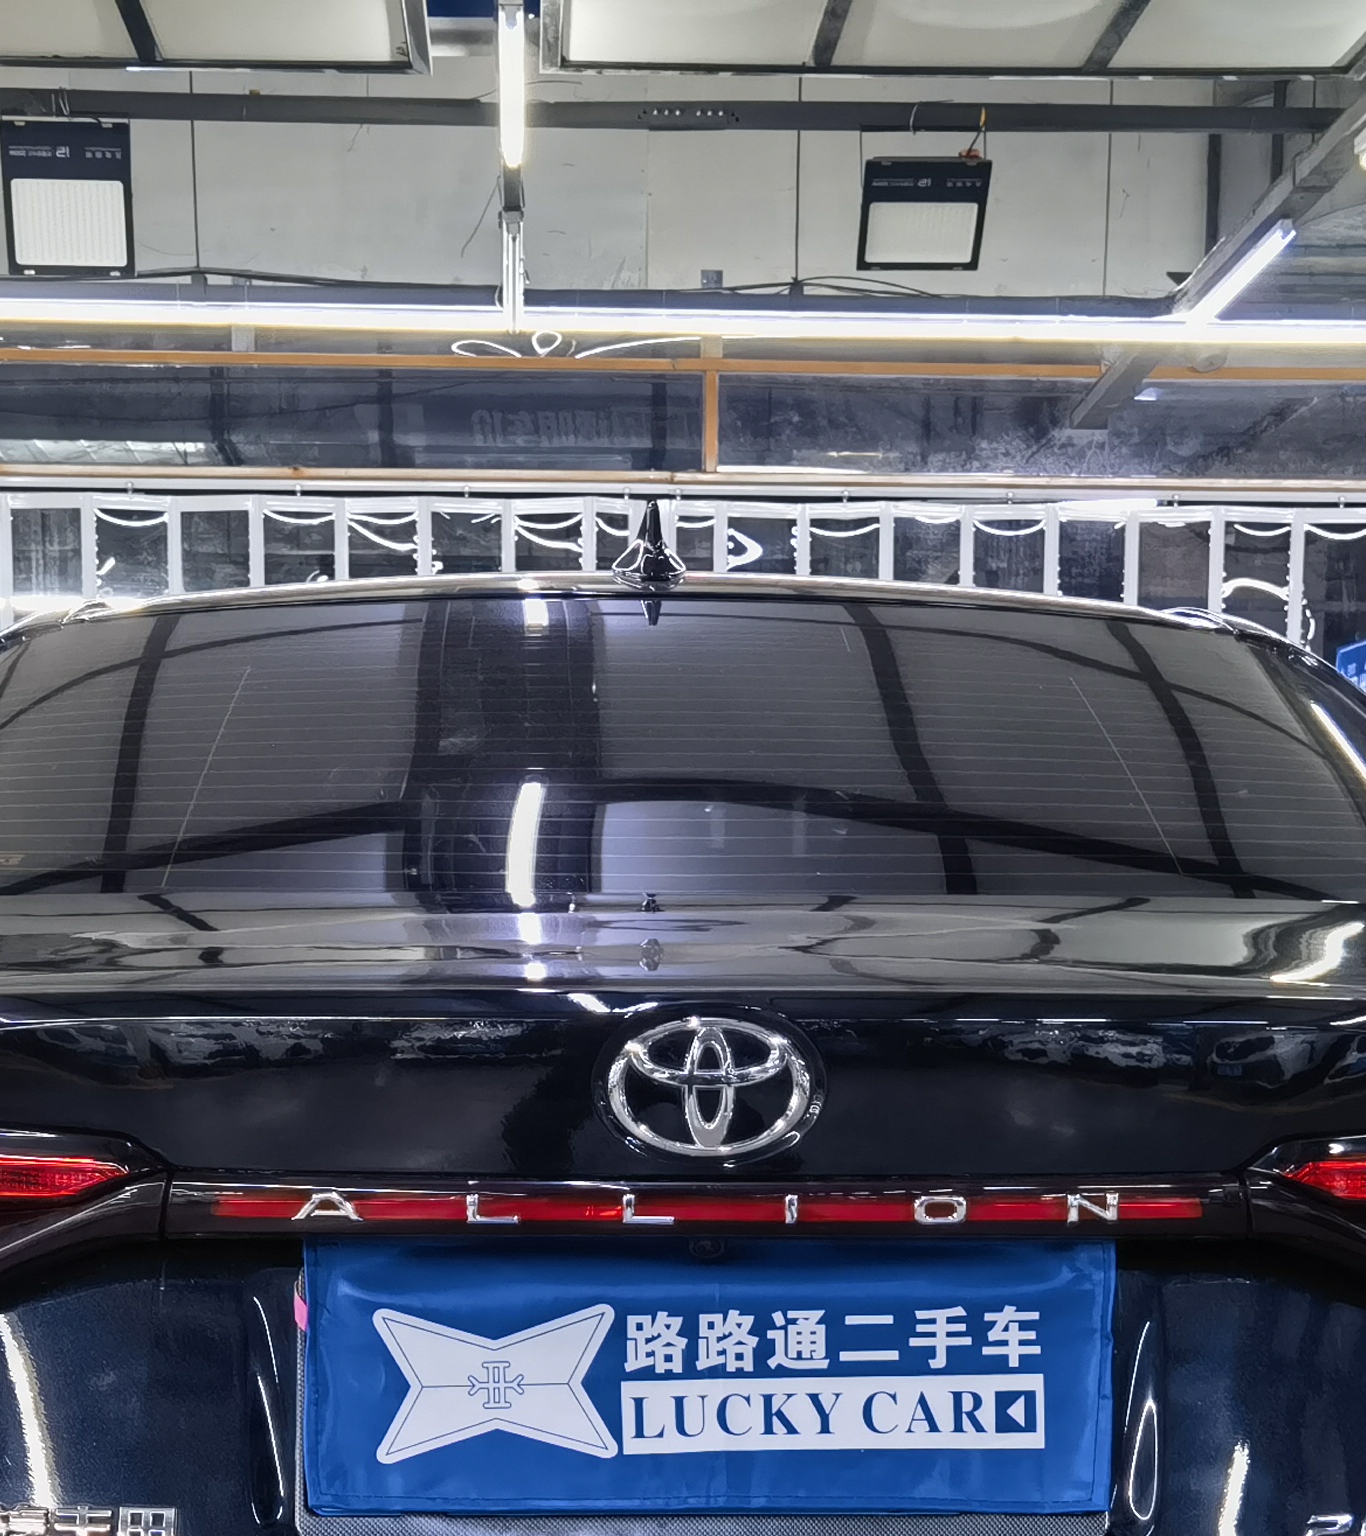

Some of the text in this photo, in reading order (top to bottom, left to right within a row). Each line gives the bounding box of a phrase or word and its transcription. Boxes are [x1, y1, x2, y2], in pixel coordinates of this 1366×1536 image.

[291, 1191, 1120, 1225] ALLION
[623, 1305, 1042, 1374] 路路通二手车
[629, 1390, 988, 1439] LUCKY CAR
